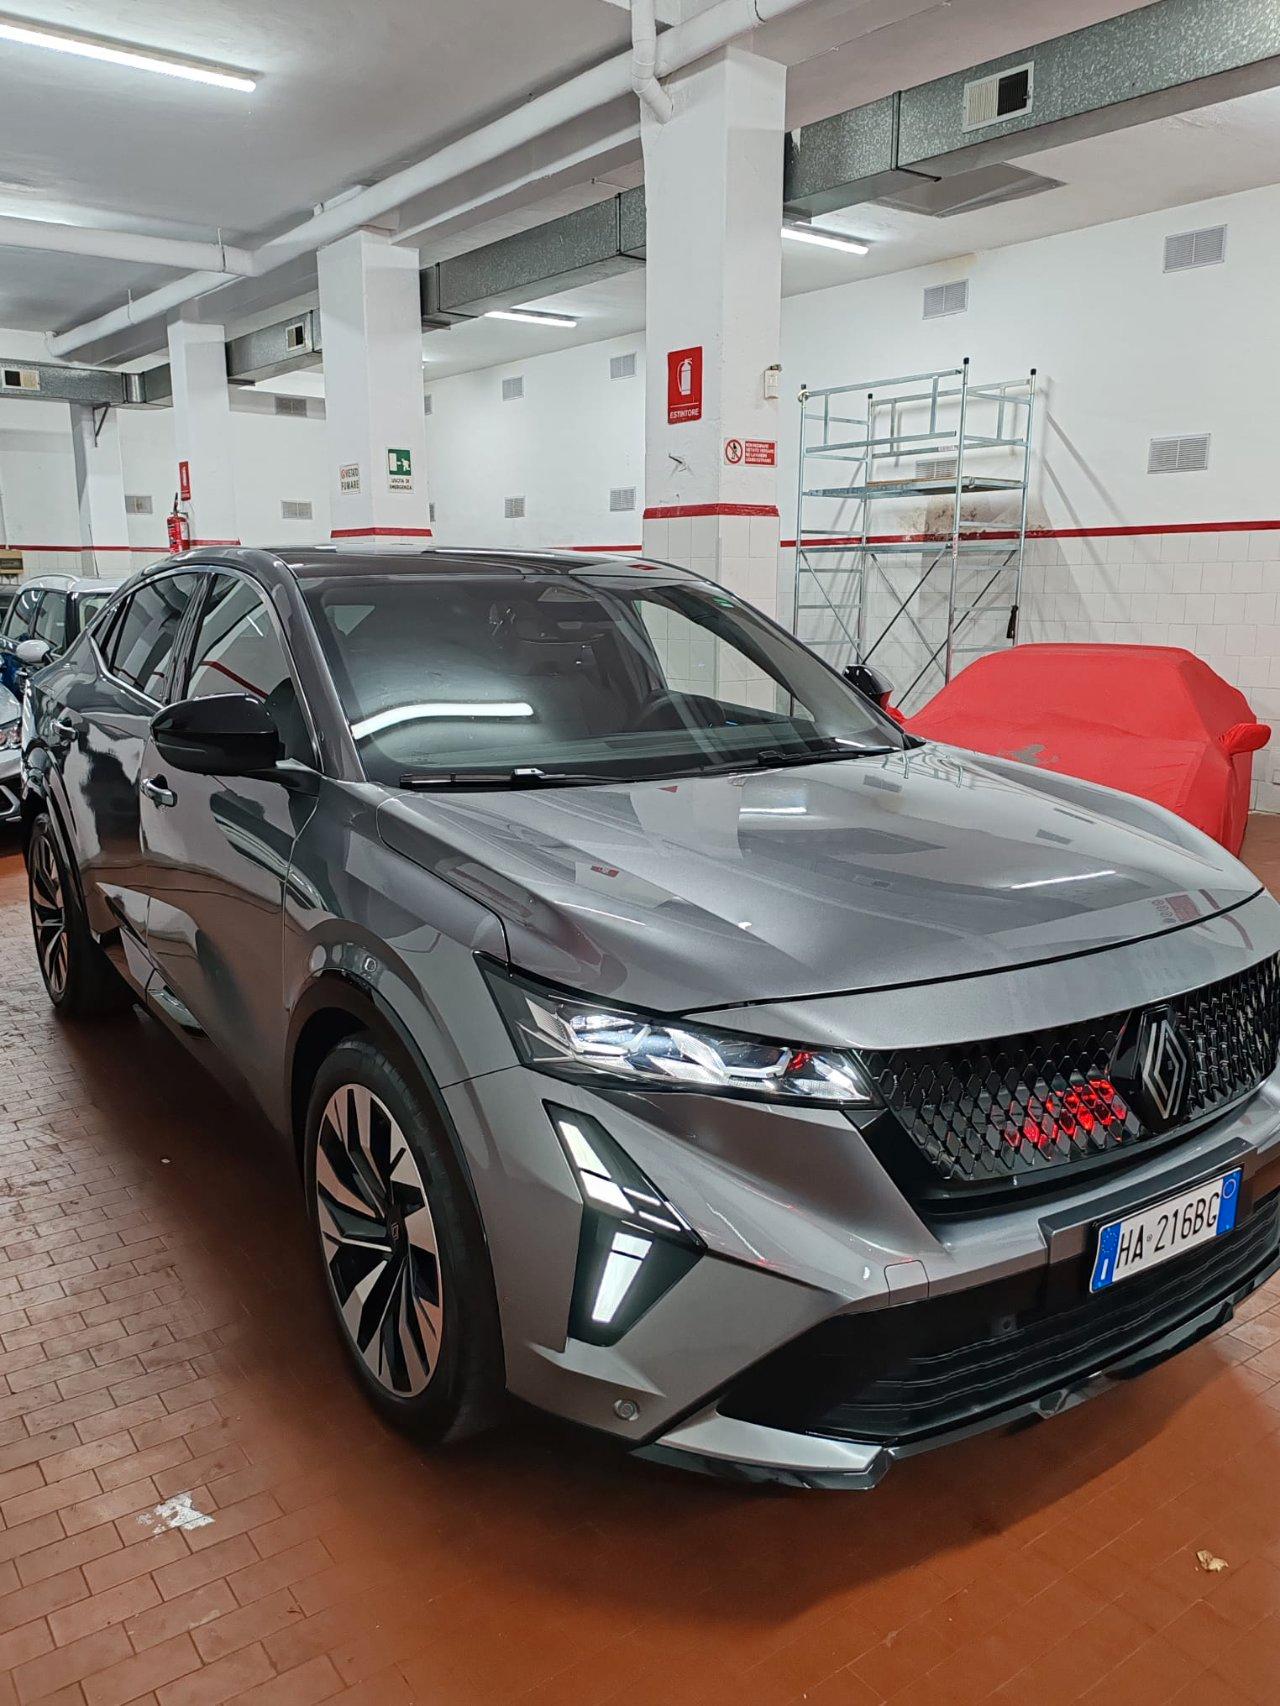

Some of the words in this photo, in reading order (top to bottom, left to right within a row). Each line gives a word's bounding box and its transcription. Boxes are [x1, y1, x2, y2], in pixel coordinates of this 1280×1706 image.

[670, 408, 699, 418] ESTINTORE
[341, 480, 359, 491] FUMARE
[1116, 1224, 1144, 1268] HA
[1153, 1192, 1220, 1253] 216BG
